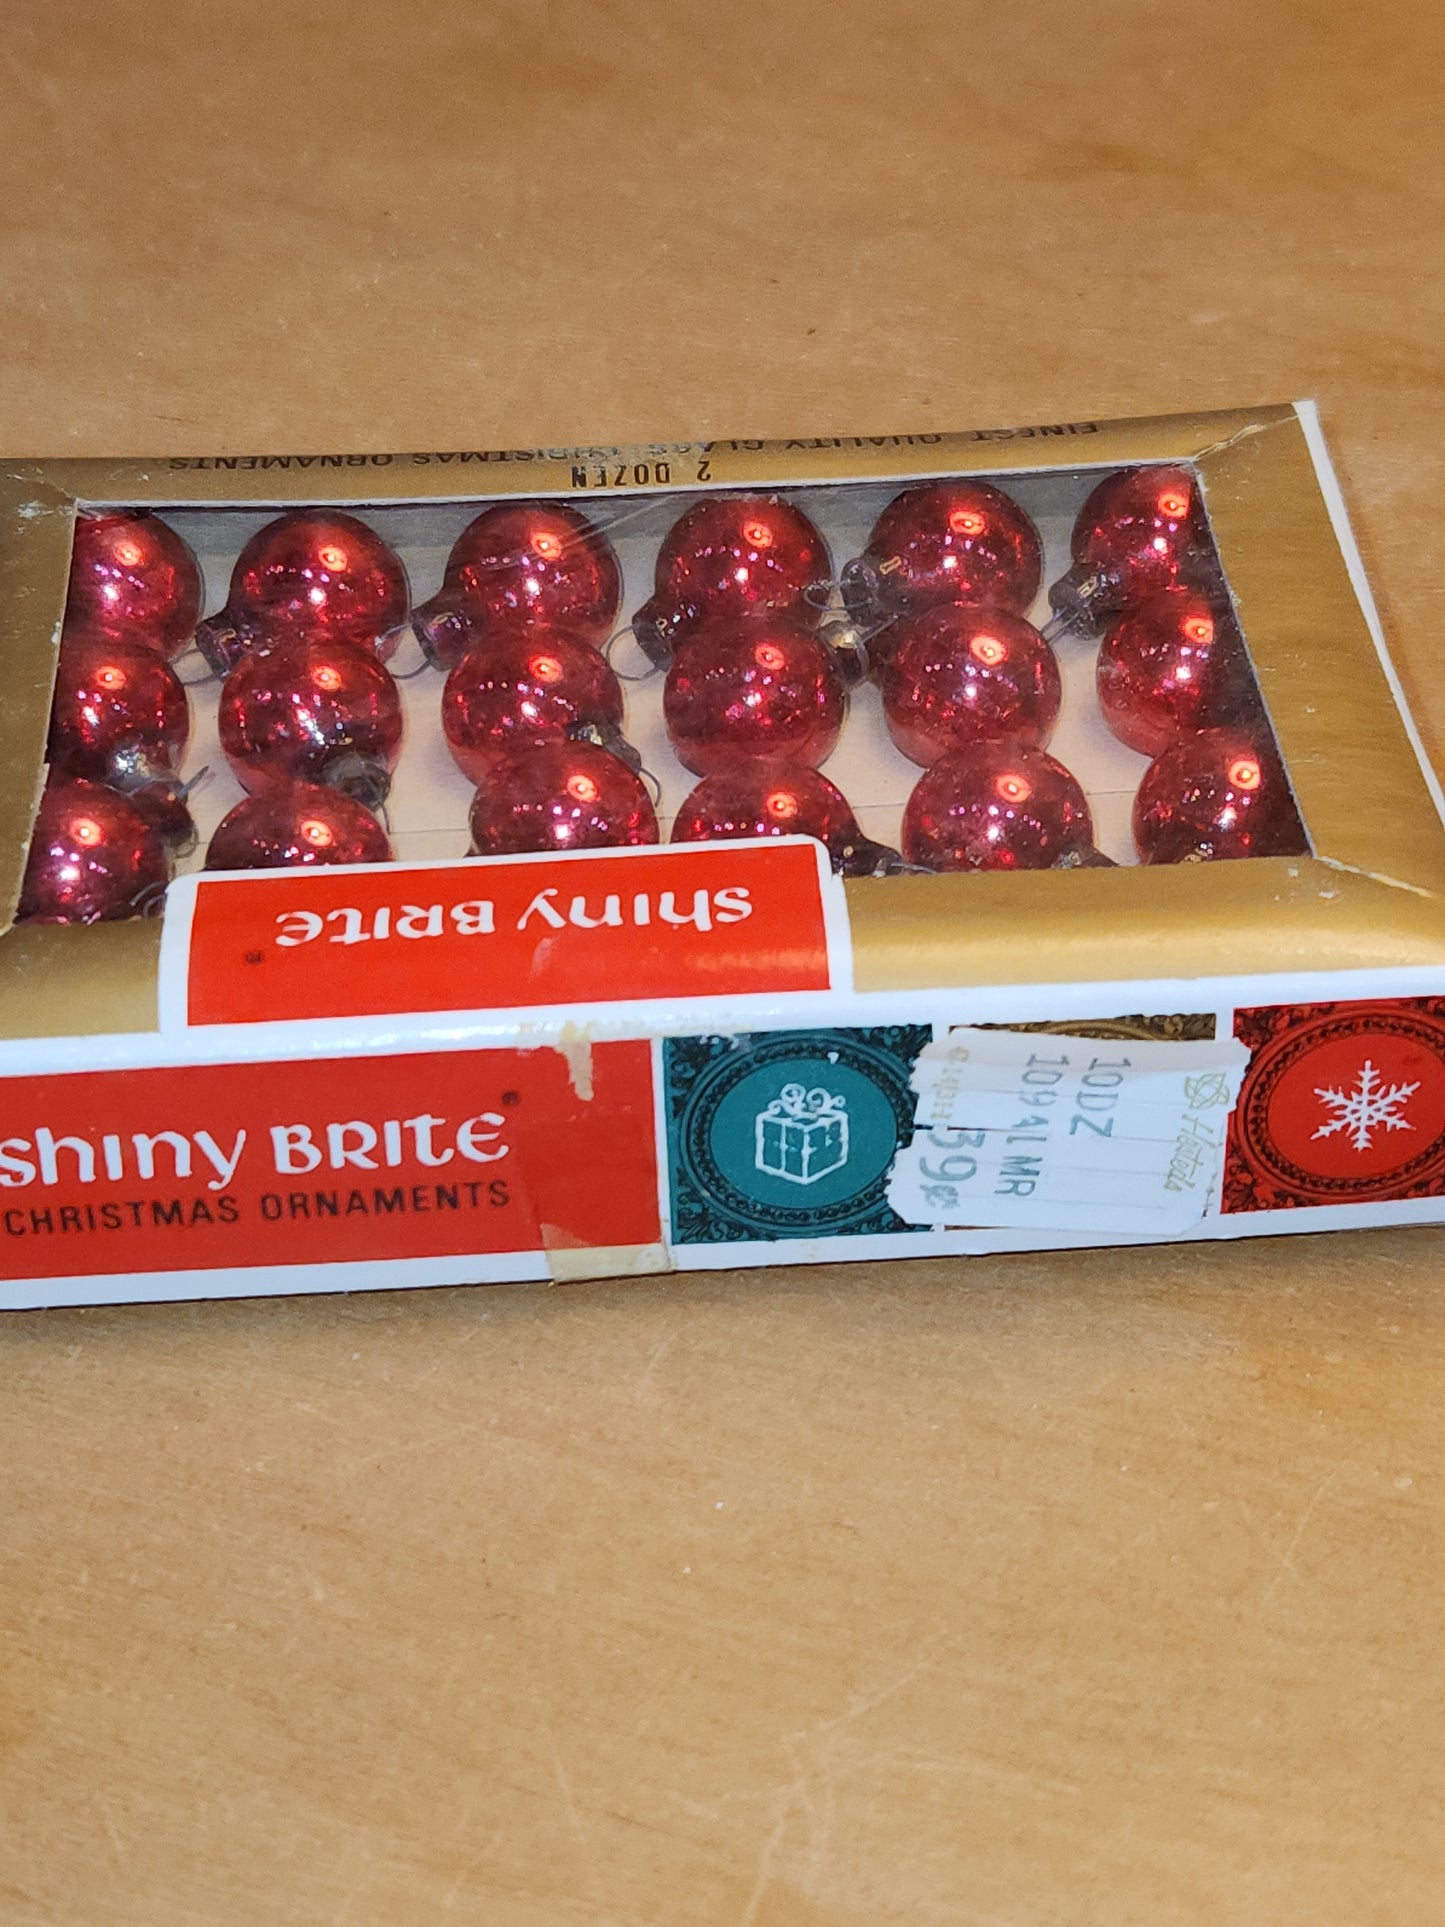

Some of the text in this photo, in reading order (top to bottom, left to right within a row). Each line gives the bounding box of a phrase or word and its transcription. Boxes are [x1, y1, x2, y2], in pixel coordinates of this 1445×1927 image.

[786, 434, 942, 450] QUALITY
[970, 422, 1100, 442] FINEST
[169, 453, 393, 470] ORNAMENTS
[571, 460, 711, 488] 2 DOZEN
[517, 886, 753, 932] shiny
[0, 1127, 247, 1190] shiny
[4, 1179, 512, 1237] CHRISTMAS ORNAMENTS
